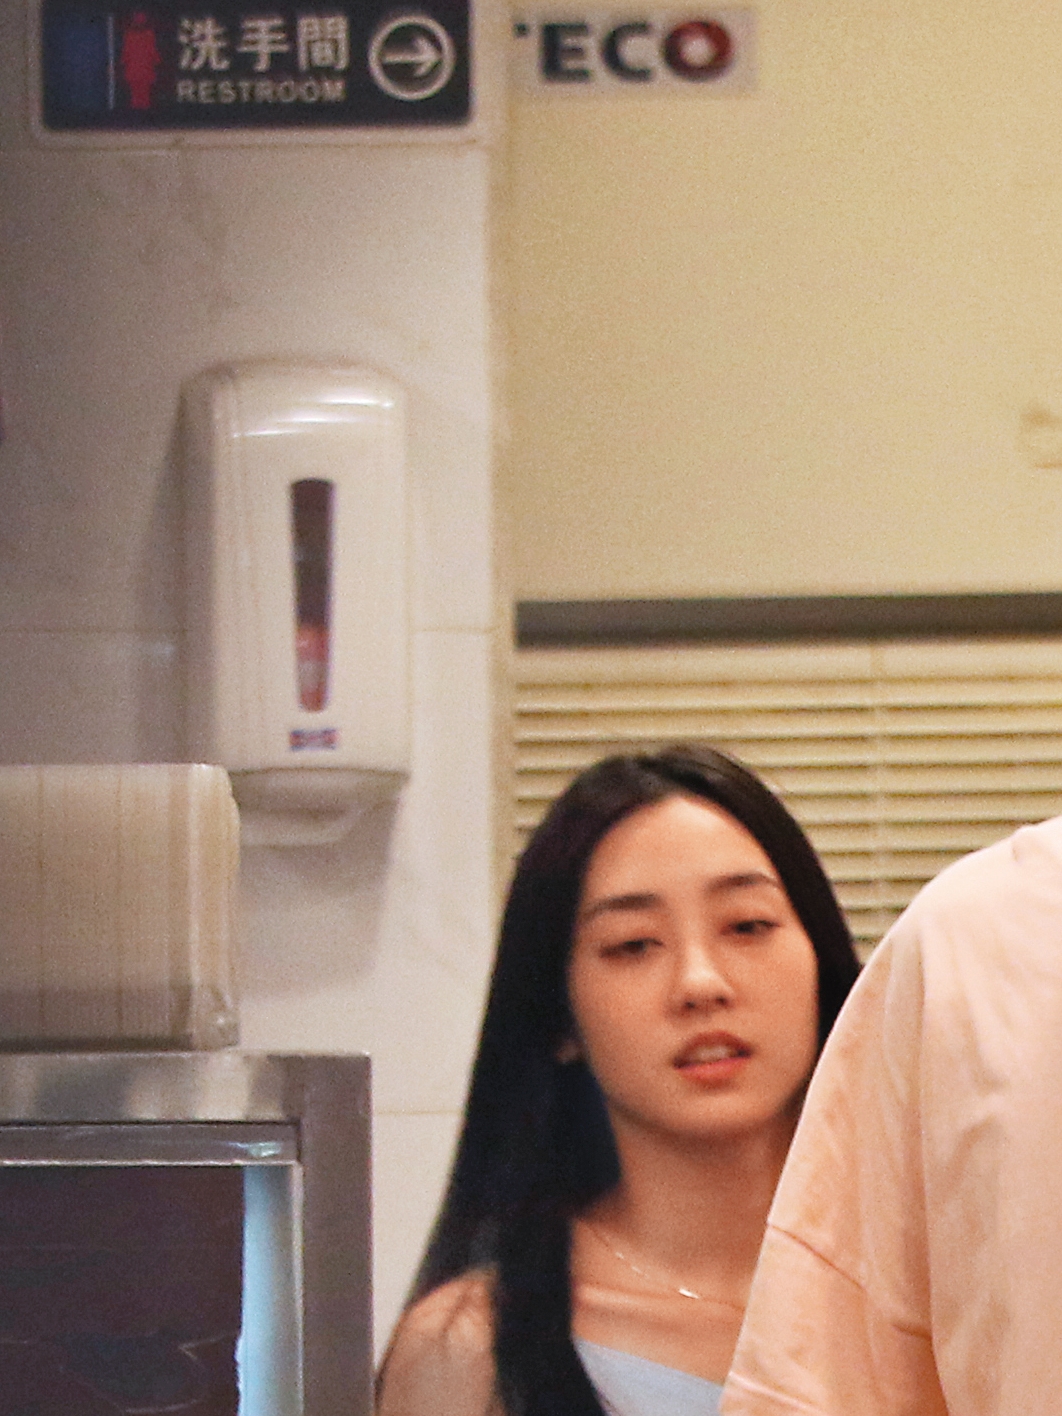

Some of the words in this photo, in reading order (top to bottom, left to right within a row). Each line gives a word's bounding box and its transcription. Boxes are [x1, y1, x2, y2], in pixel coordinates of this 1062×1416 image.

[178, 15, 348, 72] 洗手間
[514, 20, 732, 83] ECO
[176, 79, 347, 103] RESTROOM
